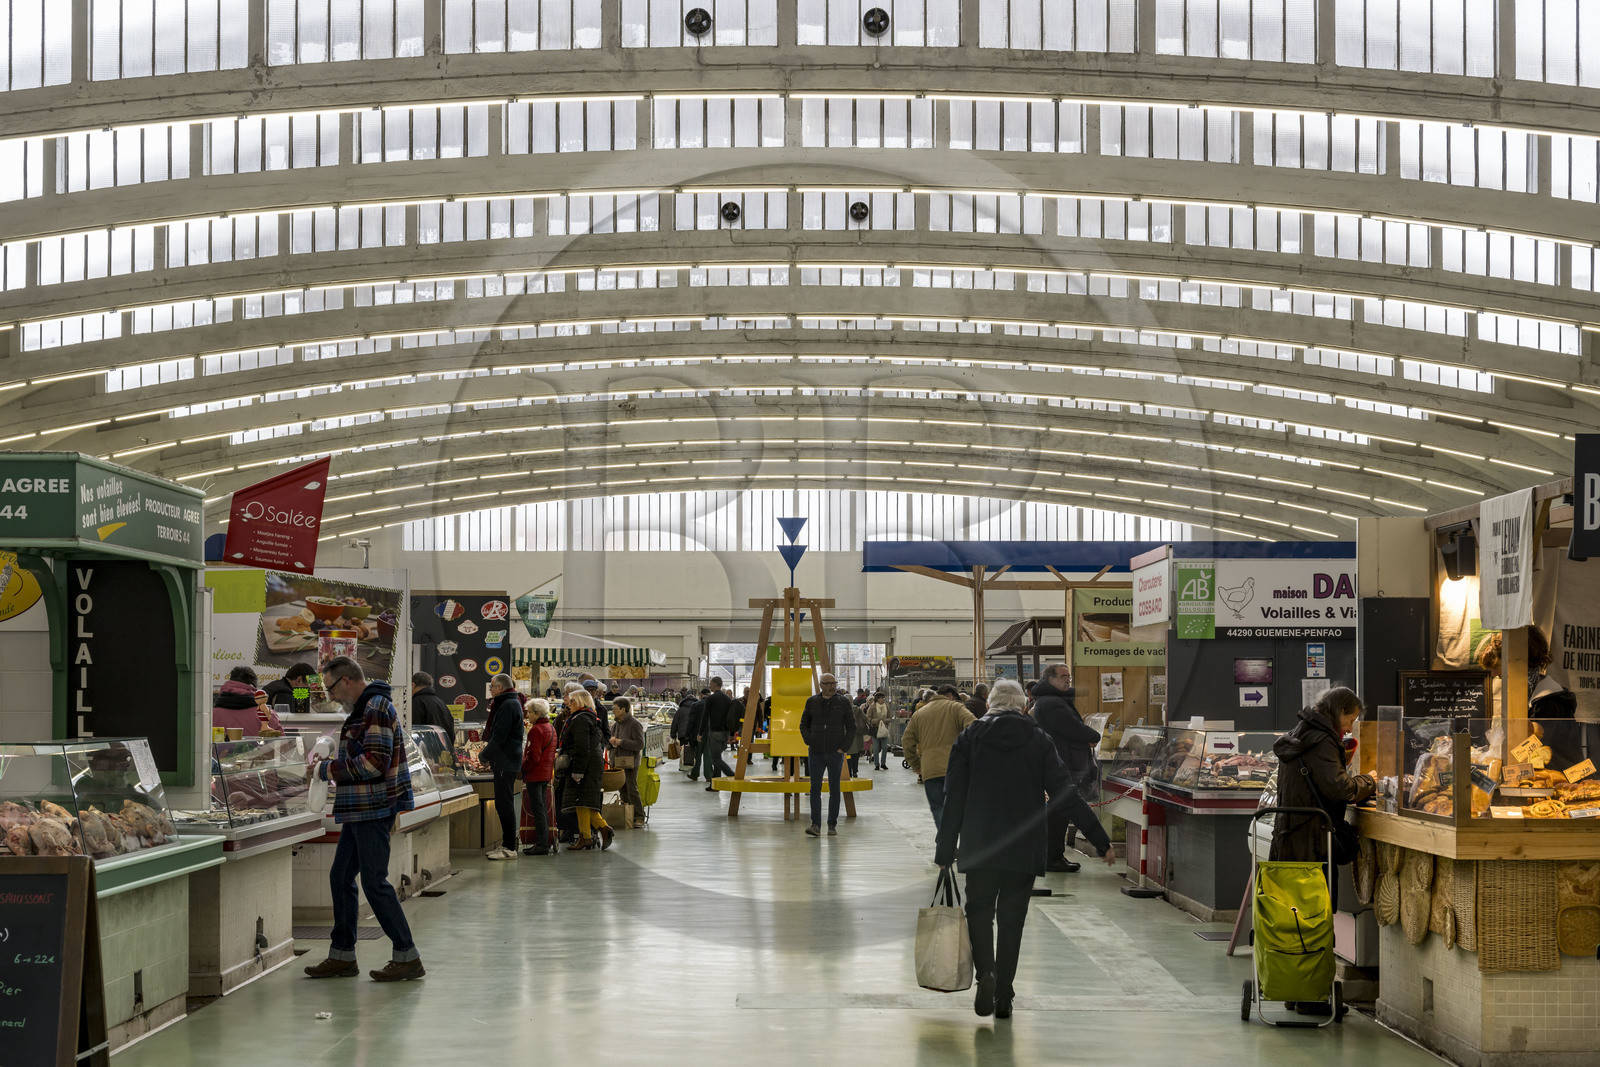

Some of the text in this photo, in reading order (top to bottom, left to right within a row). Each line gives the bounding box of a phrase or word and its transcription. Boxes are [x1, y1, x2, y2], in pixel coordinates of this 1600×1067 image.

[1, 478, 70, 494] AGREE
[80, 476, 123, 505] Nos volailles
[0, 505, 28, 520] 44
[82, 492, 141, 529] sont bien élevées!
[145, 498, 200, 524] PRODUCTEUR AGREE
[157, 525, 190, 544] TERROIRS 44
[1181, 578, 1209, 600] AB
[1273, 573, 1357, 599] maison DA
[1261, 606, 1320, 619] Volailles
[1325, 607, 1336, 619] &
[1227, 628, 1342, 637] 44290 GUEMENE-PENFAO
[1084, 646, 1131, 659] Fromages
[1133, 646, 1145, 656] de
[1563, 651, 1576, 671] DE
[1579, 676, 1596, 689] 100%
